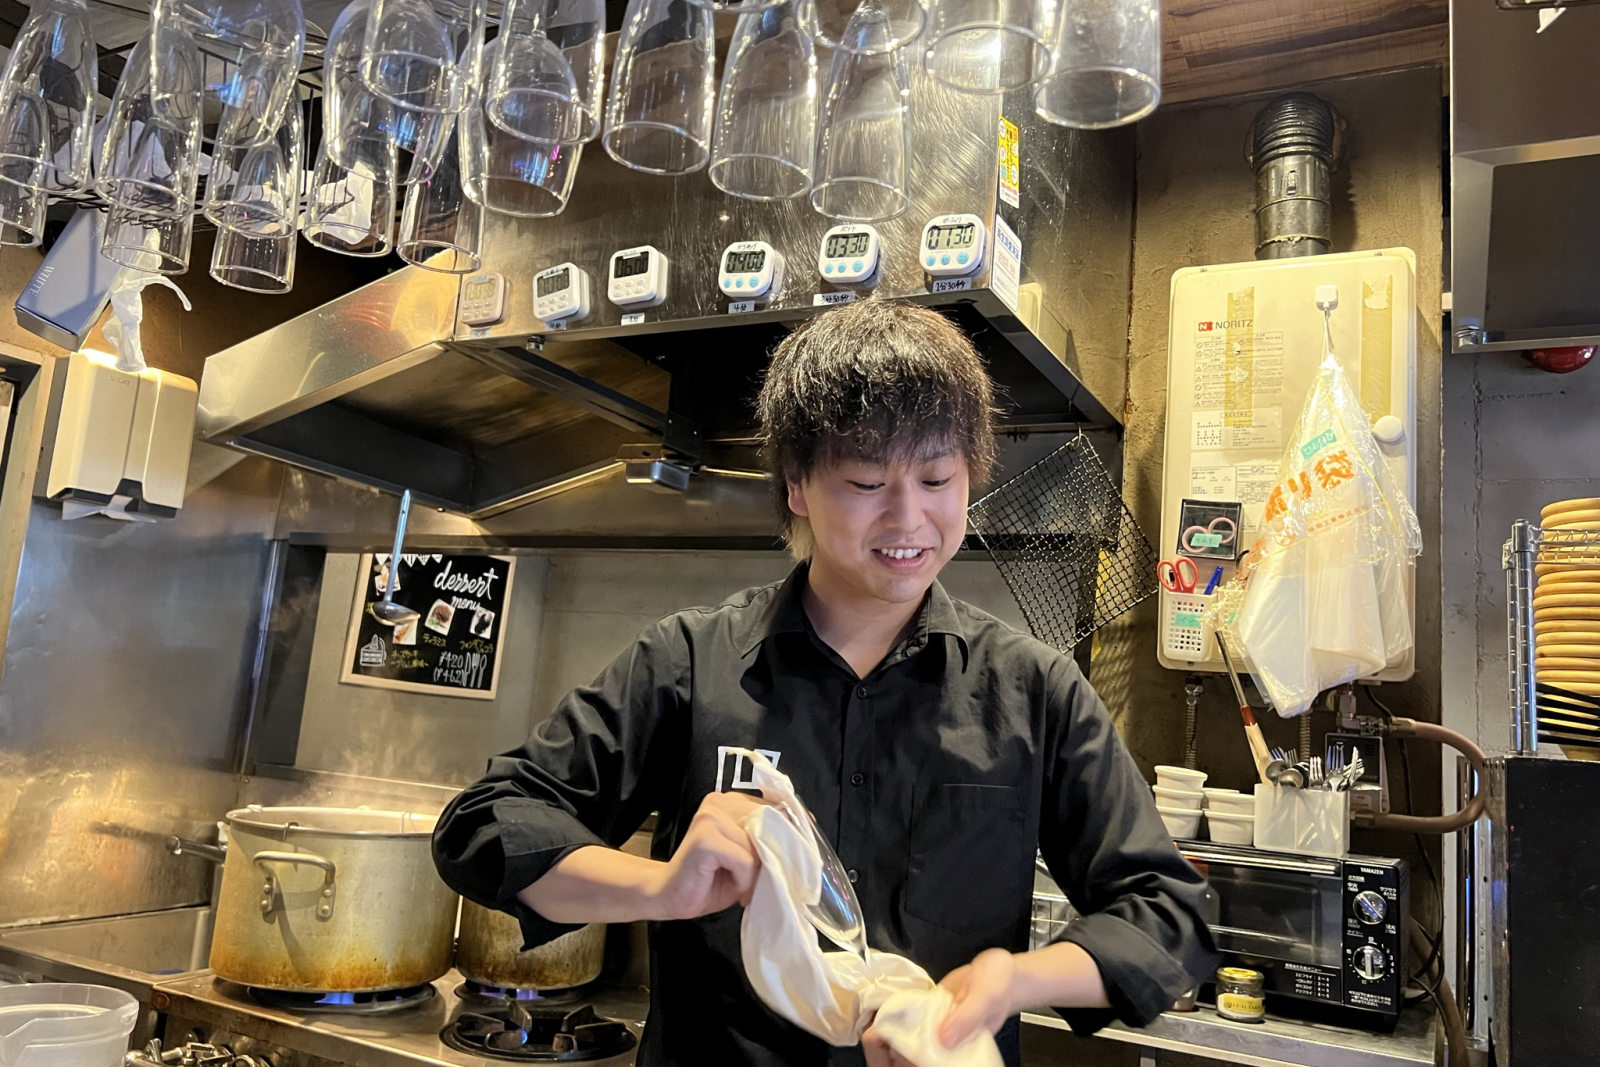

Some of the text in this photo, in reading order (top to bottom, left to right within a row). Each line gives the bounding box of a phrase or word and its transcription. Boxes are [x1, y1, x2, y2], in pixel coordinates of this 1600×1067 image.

[827, 233, 869, 258] 0330
[1215, 319, 1253, 329] NORITZ
[434, 560, 499, 600] dessert
[450, 596, 480, 611] menu
[1360, 867, 1384, 875] YAMAZEN
